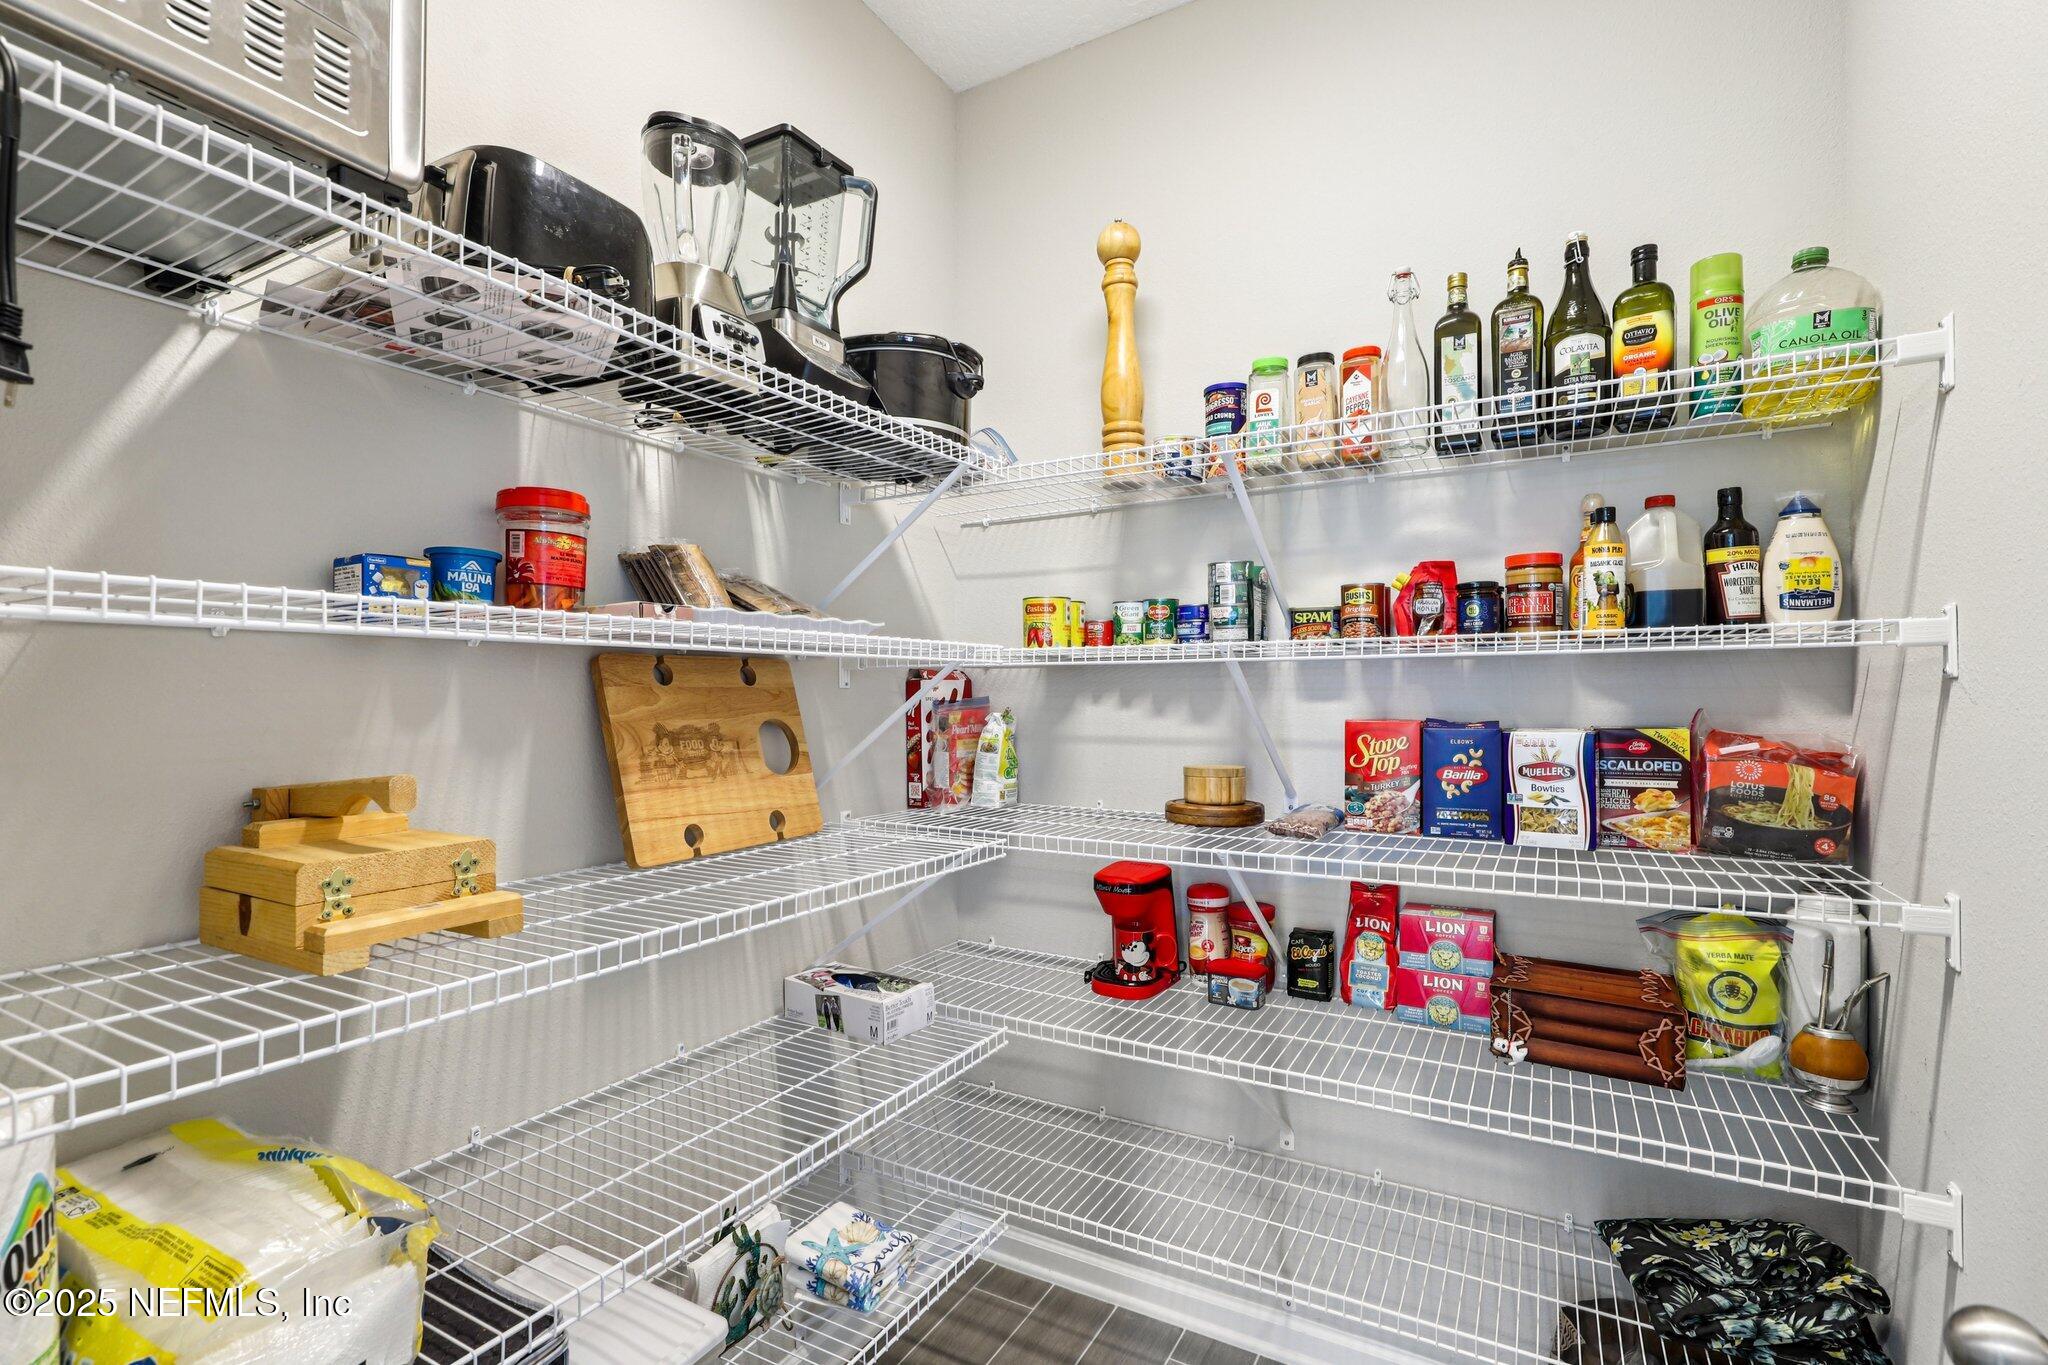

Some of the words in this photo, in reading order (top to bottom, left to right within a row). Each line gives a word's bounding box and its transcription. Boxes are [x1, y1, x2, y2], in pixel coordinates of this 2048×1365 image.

[1704, 307, 1740, 320] OLIVE
[1708, 318, 1731, 328] OIL
[1624, 327, 1655, 339] OTTAVIO
[1779, 331, 1838, 349] CANOLA
[1841, 330, 1862, 340] OIL
[1559, 342, 1600, 355] COLAVITA
[1623, 350, 1657, 361] ORGANIC
[1444, 375, 1476, 384] TOSCANO
[1345, 390, 1370, 405] CAYENNE
[1345, 400, 1371, 415] PEPPER
[1733, 562, 1757, 571] HEINZ
[447, 571, 493, 586] MAUNA
[462, 581, 480, 593] LOA
[1740, 586, 1754, 595] SAUCE
[1345, 591, 1371, 601] BUSH'S
[1783, 597, 1832, 606] HELLMANN'S
[1508, 597, 1550, 607] PEANUT
[1027, 605, 1054, 613] Pastene
[1508, 604, 1550, 614] BUTTER
[1294, 612, 1332, 623] SPAM
[952, 724, 969, 735] Pearl
[1653, 731, 1670, 745] TWIN
[680, 740, 704, 750] FOOD
[1671, 741, 1689, 754] PACK
[1350, 734, 1409, 768] Stove
[1370, 755, 1400, 777] Top
[1522, 766, 1571, 777] MUELLER'S
[1600, 760, 1683, 772] SCALLOPED
[1443, 769, 1482, 780] Barilla
[1371, 780, 1400, 791] TURKEY
[1531, 784, 1565, 793] Bowties
[1731, 780, 1765, 790] LOTUS
[1612, 789, 1631, 798] REAL
[1730, 788, 1764, 797] FOODS
[1356, 917, 1391, 933] LION
[1425, 920, 1465, 935] LION
[1733, 953, 1755, 961] MATE
[1423, 975, 1463, 991] LION
